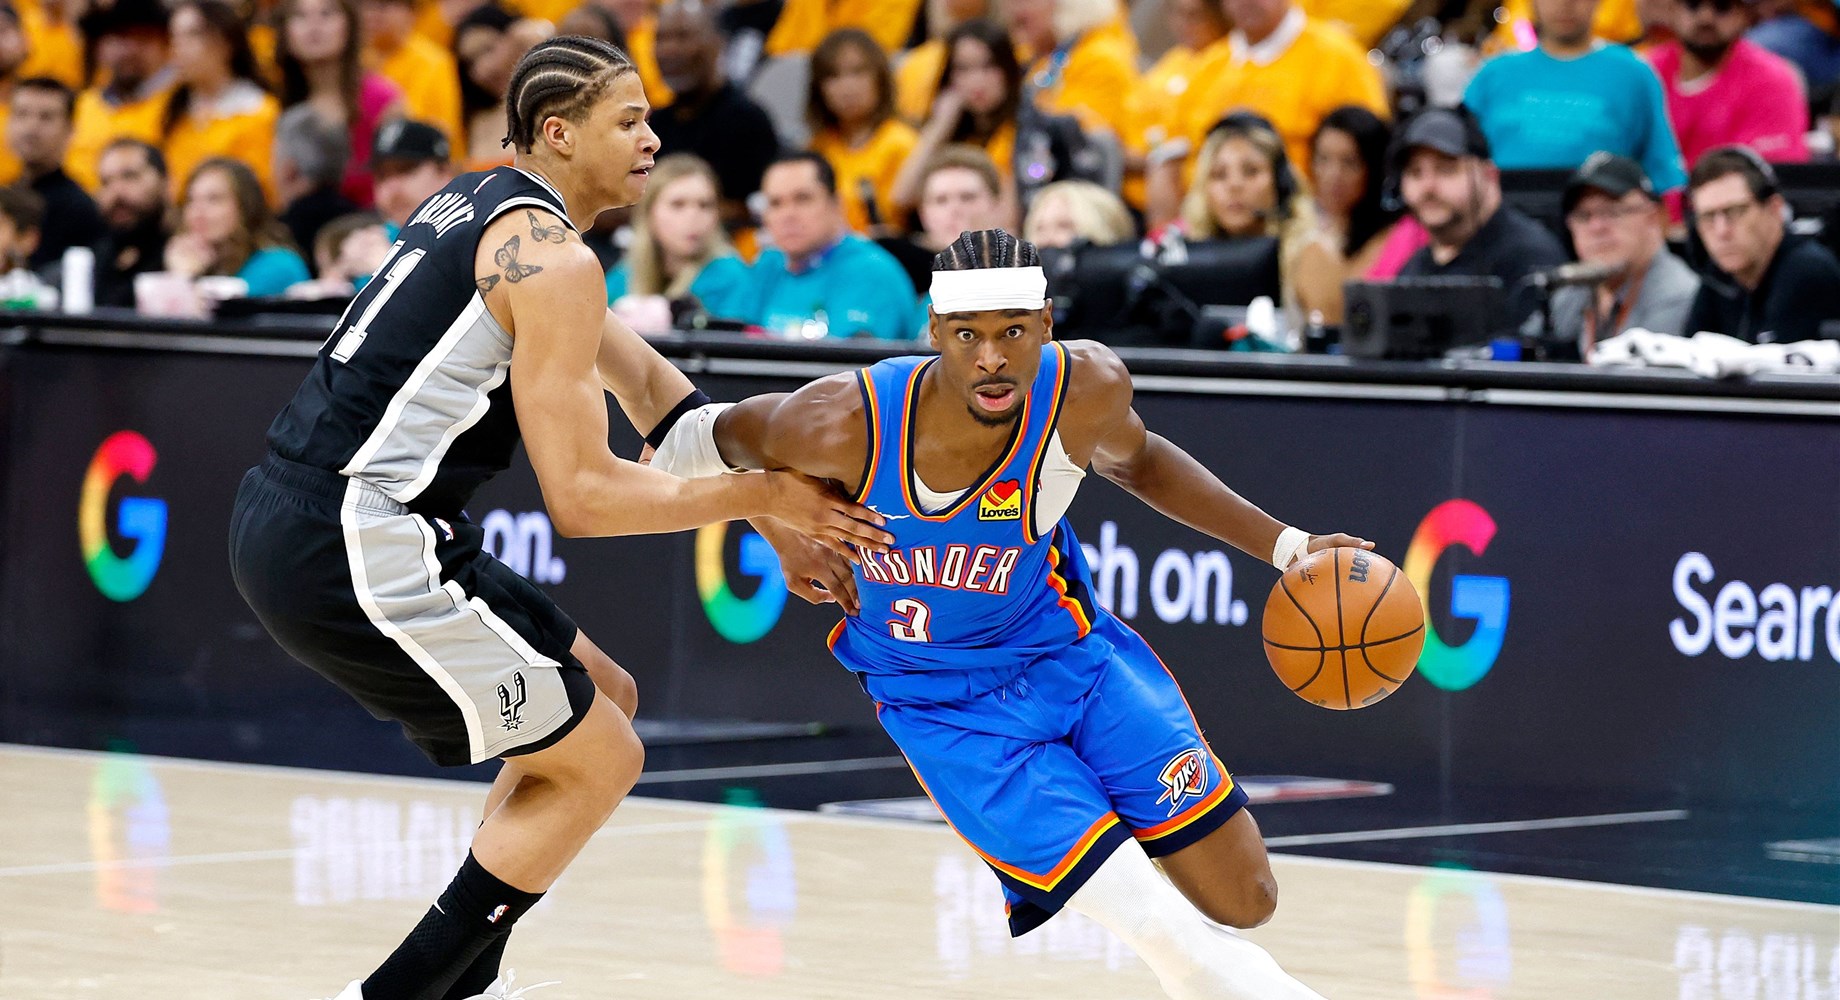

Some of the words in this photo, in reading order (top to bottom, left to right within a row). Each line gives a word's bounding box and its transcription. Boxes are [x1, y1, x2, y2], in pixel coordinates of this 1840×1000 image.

[78, 429, 169, 602] G
[1149, 548, 1249, 627] on.
[1401, 498, 1511, 692] G
